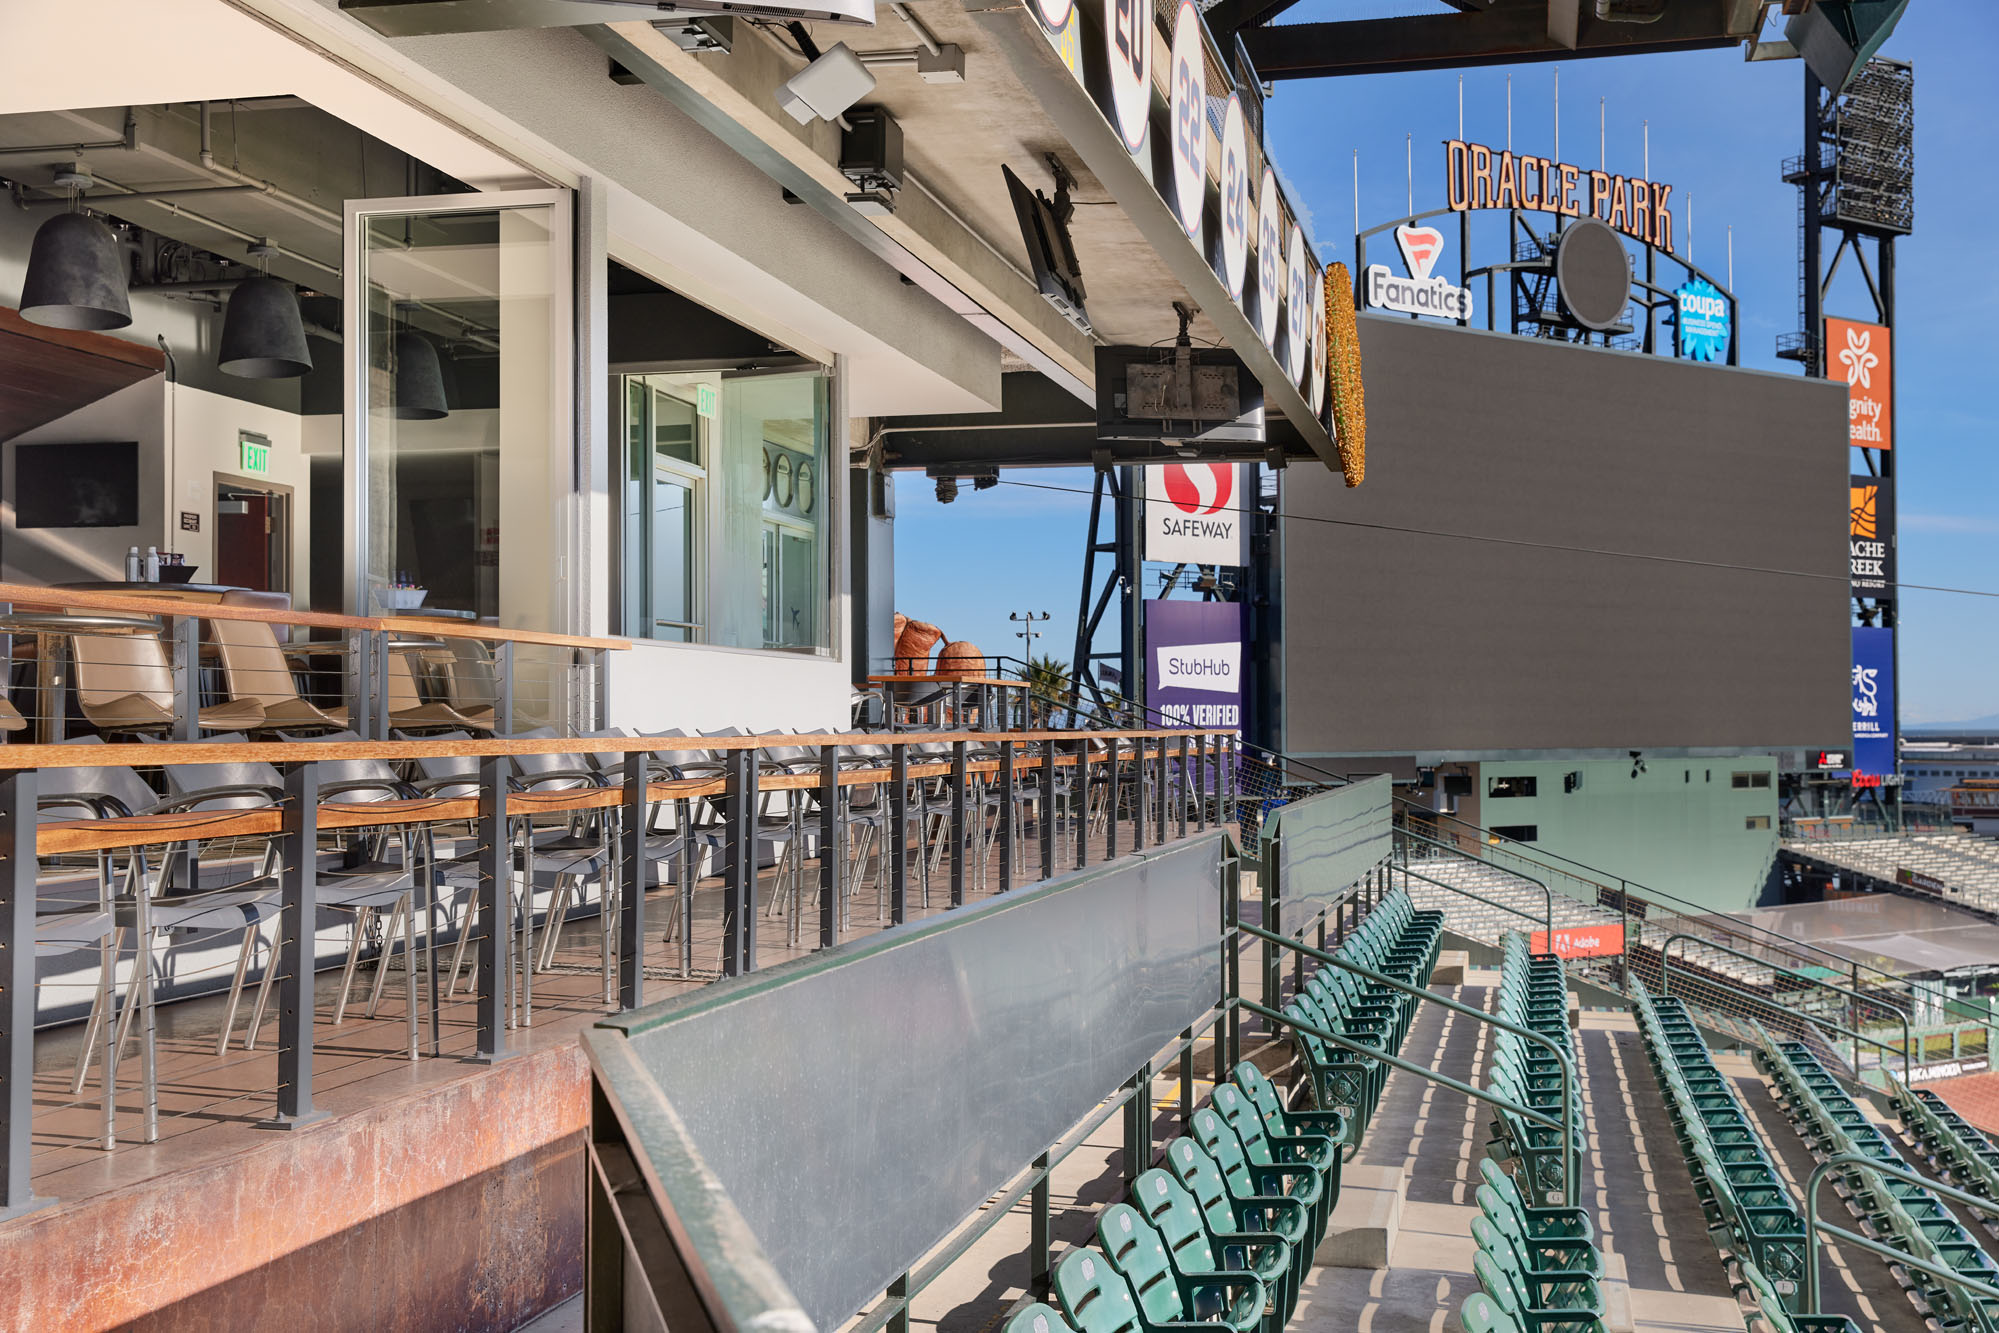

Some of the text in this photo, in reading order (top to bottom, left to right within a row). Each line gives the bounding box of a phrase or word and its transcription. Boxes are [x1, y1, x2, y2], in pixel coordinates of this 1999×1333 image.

[1178, 56, 1201, 180] 22
[1226, 146, 1245, 250] 24
[1446, 139, 1674, 253] ORACLE PARK
[1262, 214, 1276, 301] 25
[1292, 266, 1304, 341] 27
[1373, 272, 1468, 314] Fanatics
[1680, 293, 1725, 320] coupa
[701, 388, 715, 416] EXIT
[247, 446, 267, 472] EXIT
[1163, 517, 1232, 539] SAFEWAY
[1168, 657, 1230, 676] StubHub
[1160, 704, 1240, 726] 100% VERIFIED
[1881, 774, 1904, 786] LIGHT
[1573, 935, 1600, 948] Adobe
